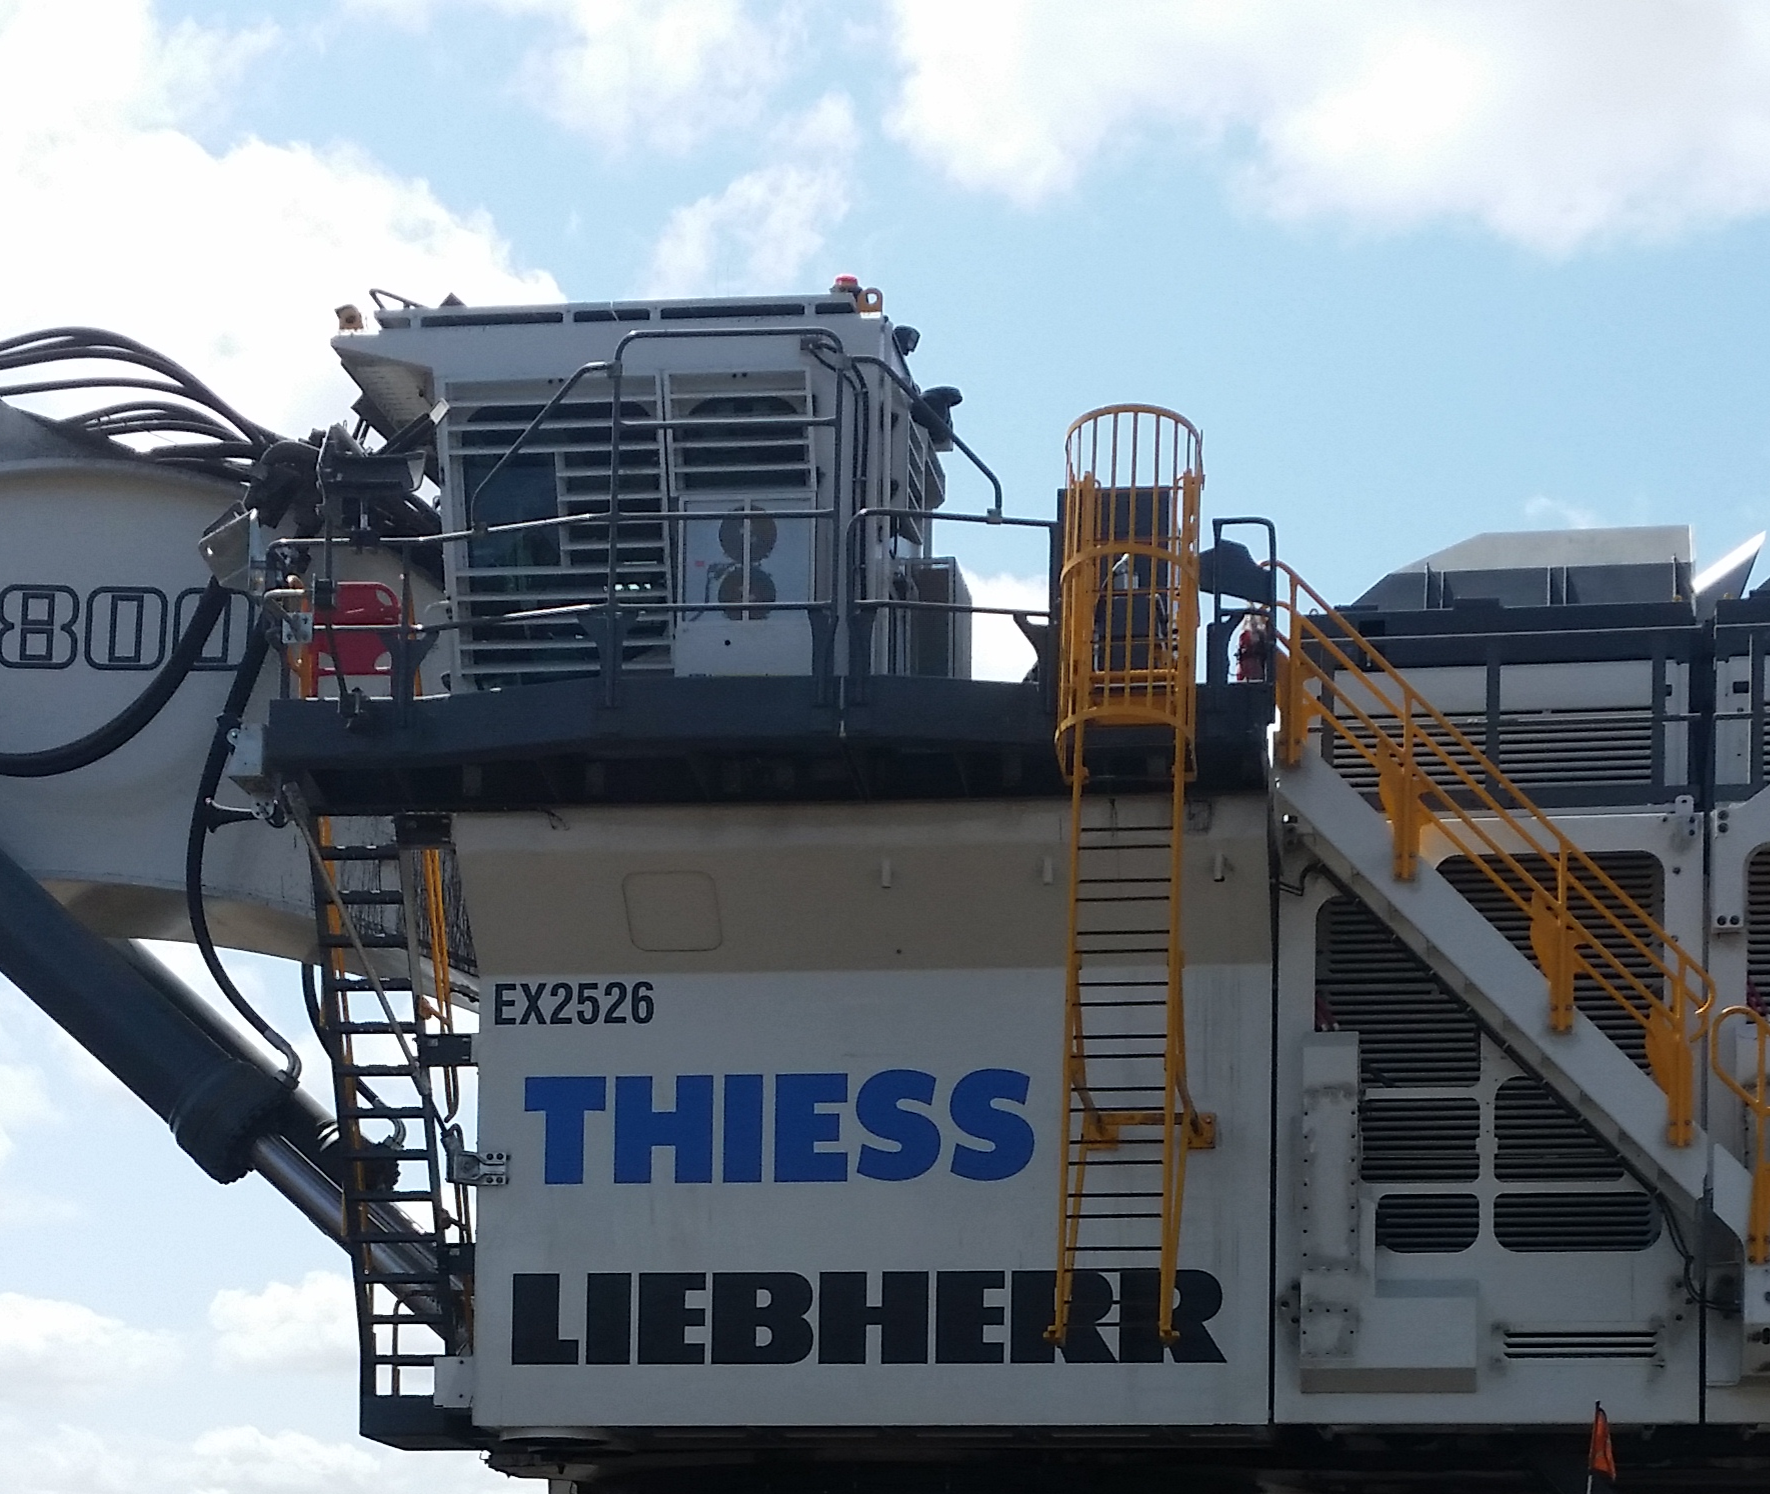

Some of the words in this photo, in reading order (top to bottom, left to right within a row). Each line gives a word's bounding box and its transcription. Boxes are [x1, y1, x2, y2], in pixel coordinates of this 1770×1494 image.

[493, 980, 655, 1026] EX2526
[523, 1067, 1036, 1185] THIESS
[511, 1269, 1228, 1367] LIEBHERR
